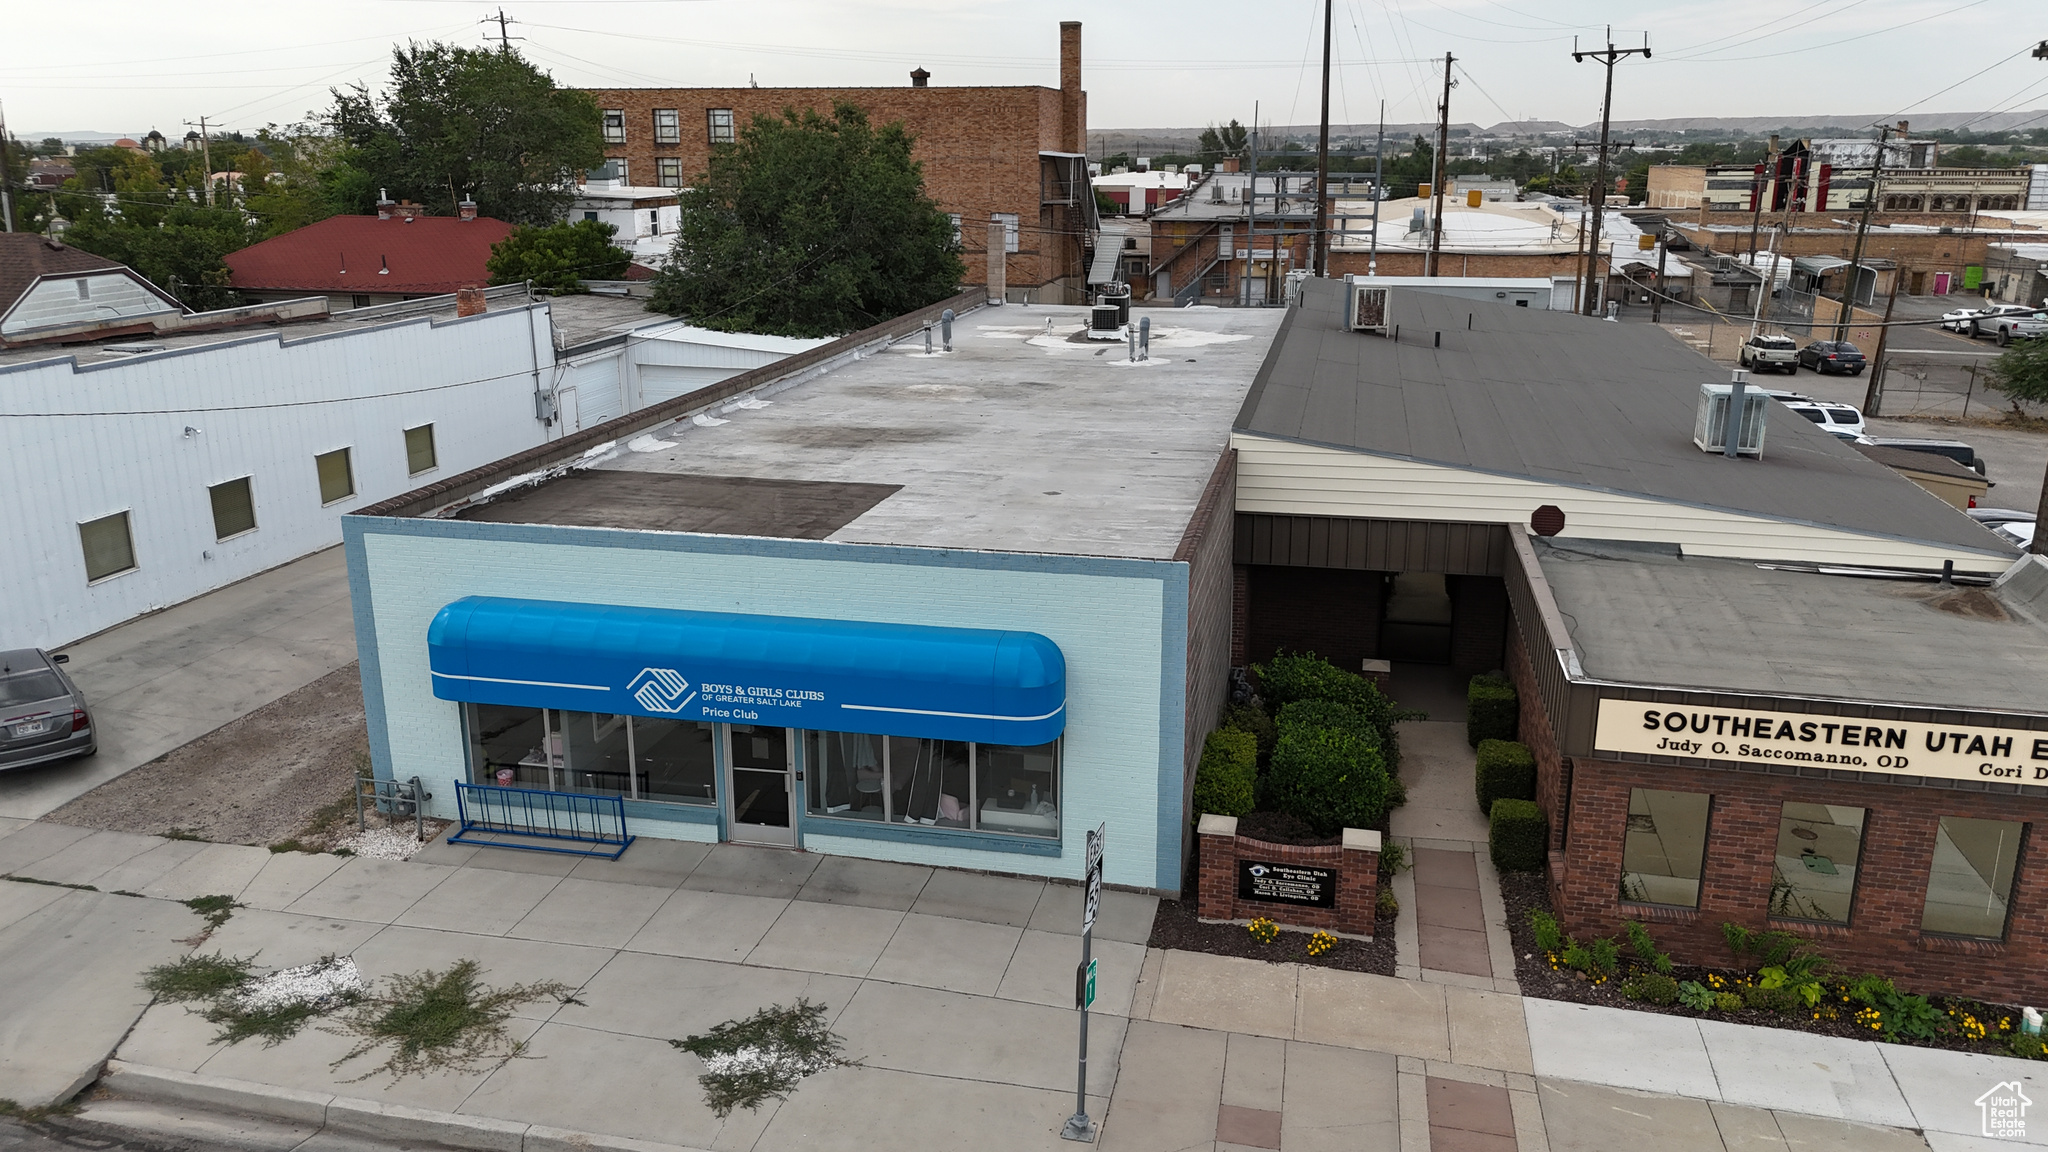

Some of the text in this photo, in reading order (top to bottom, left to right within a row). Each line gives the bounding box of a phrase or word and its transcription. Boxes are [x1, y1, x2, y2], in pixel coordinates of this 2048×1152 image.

[701, 683, 825, 701] BOYS & GIRLS CLUBS
[715, 694, 755, 705] GREATER
[756, 698, 777, 706] SALT
[779, 699, 802, 708] LAKE
[702, 706, 759, 720] Price Club
[1643, 710, 1907, 749] SOUTHEASTERN
[1925, 730, 2013, 758] UTAH
[1656, 737, 1909, 769] Judy O. Saccomanno, OD
[1979, 763, 2023, 778] Cori
[1089, 832, 1102, 866] EAST
[1272, 866, 1311, 875] Southeastern
[1088, 881, 1100, 913] 55
